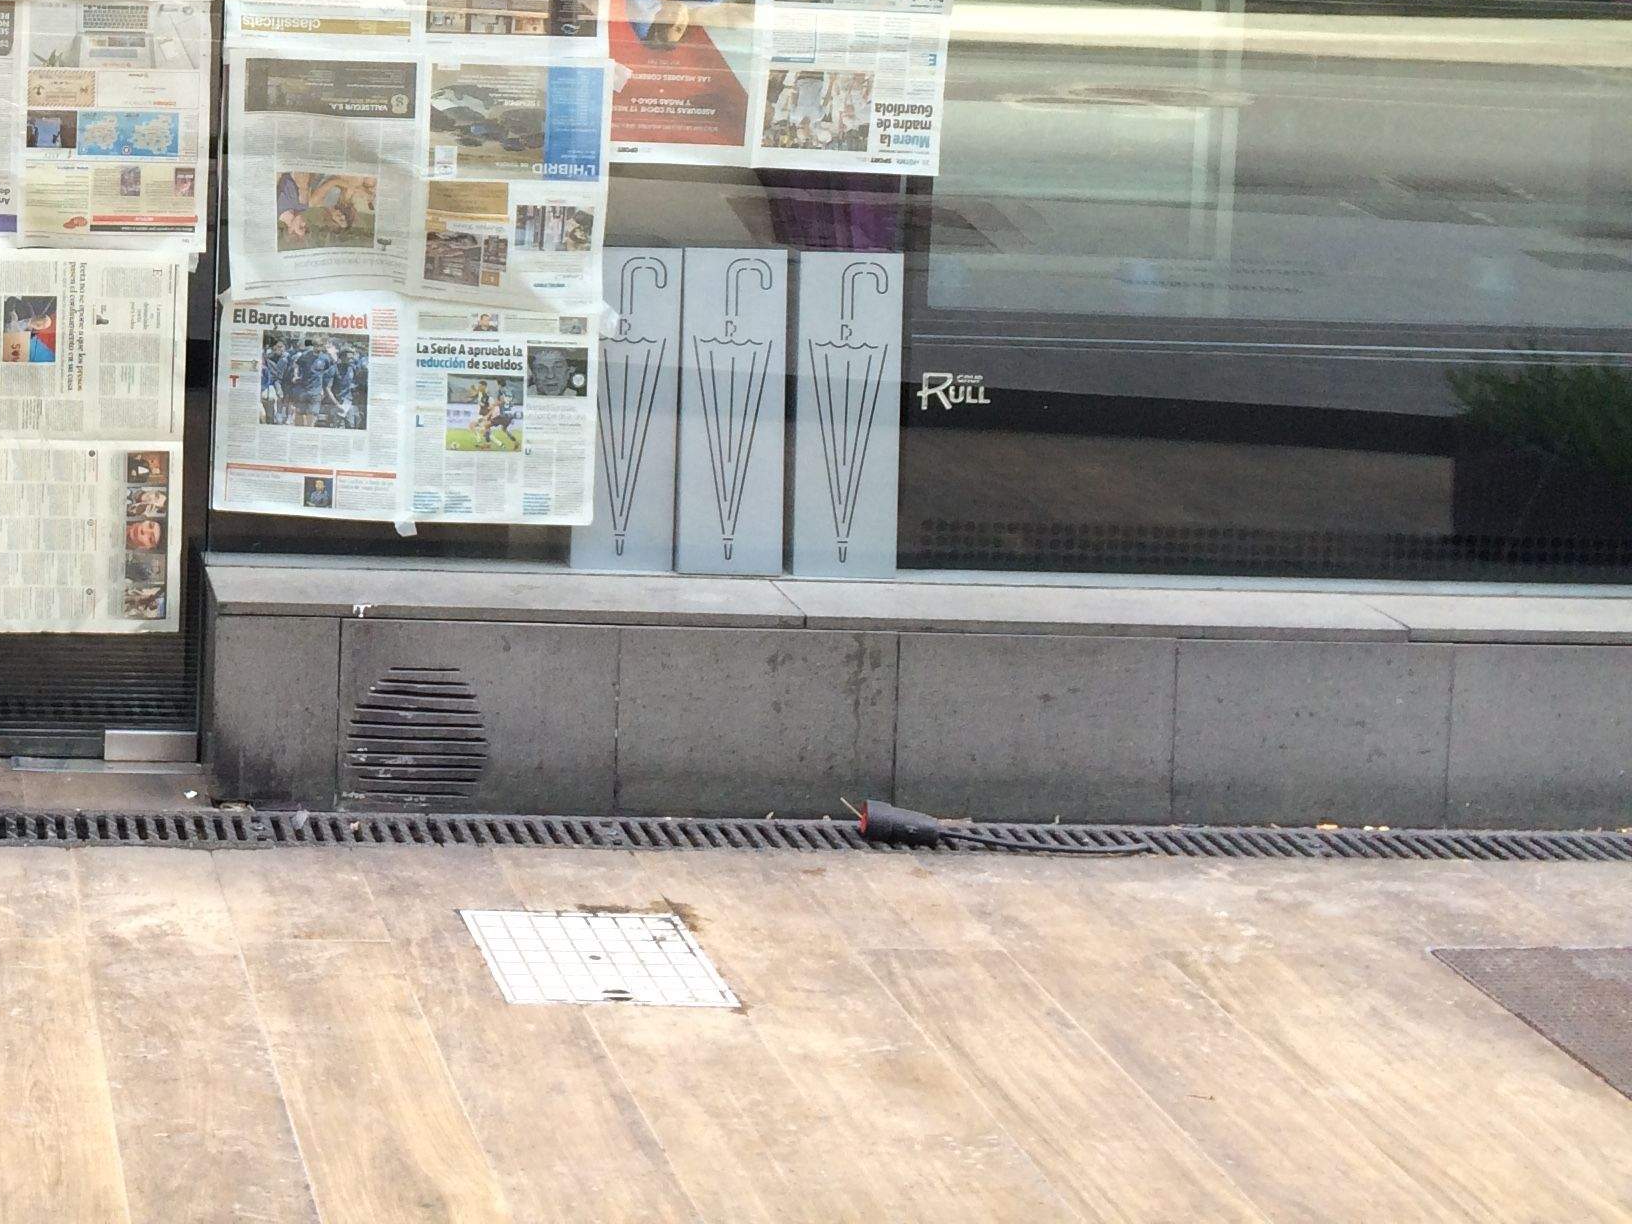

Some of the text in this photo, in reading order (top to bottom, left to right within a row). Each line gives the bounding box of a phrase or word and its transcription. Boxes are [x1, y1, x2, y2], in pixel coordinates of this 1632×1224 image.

[241, 14, 321, 30] classificats
[875, 101, 934, 118] Guardiola
[876, 118, 932, 133] madre de
[880, 133, 930, 150] Muere la
[233, 308, 368, 330] El Barça busca hotel
[416, 342, 523, 359] La Serie A aprueba la
[416, 356, 523, 371] reducción de sueldos
[917, 372, 991, 410] RULL
